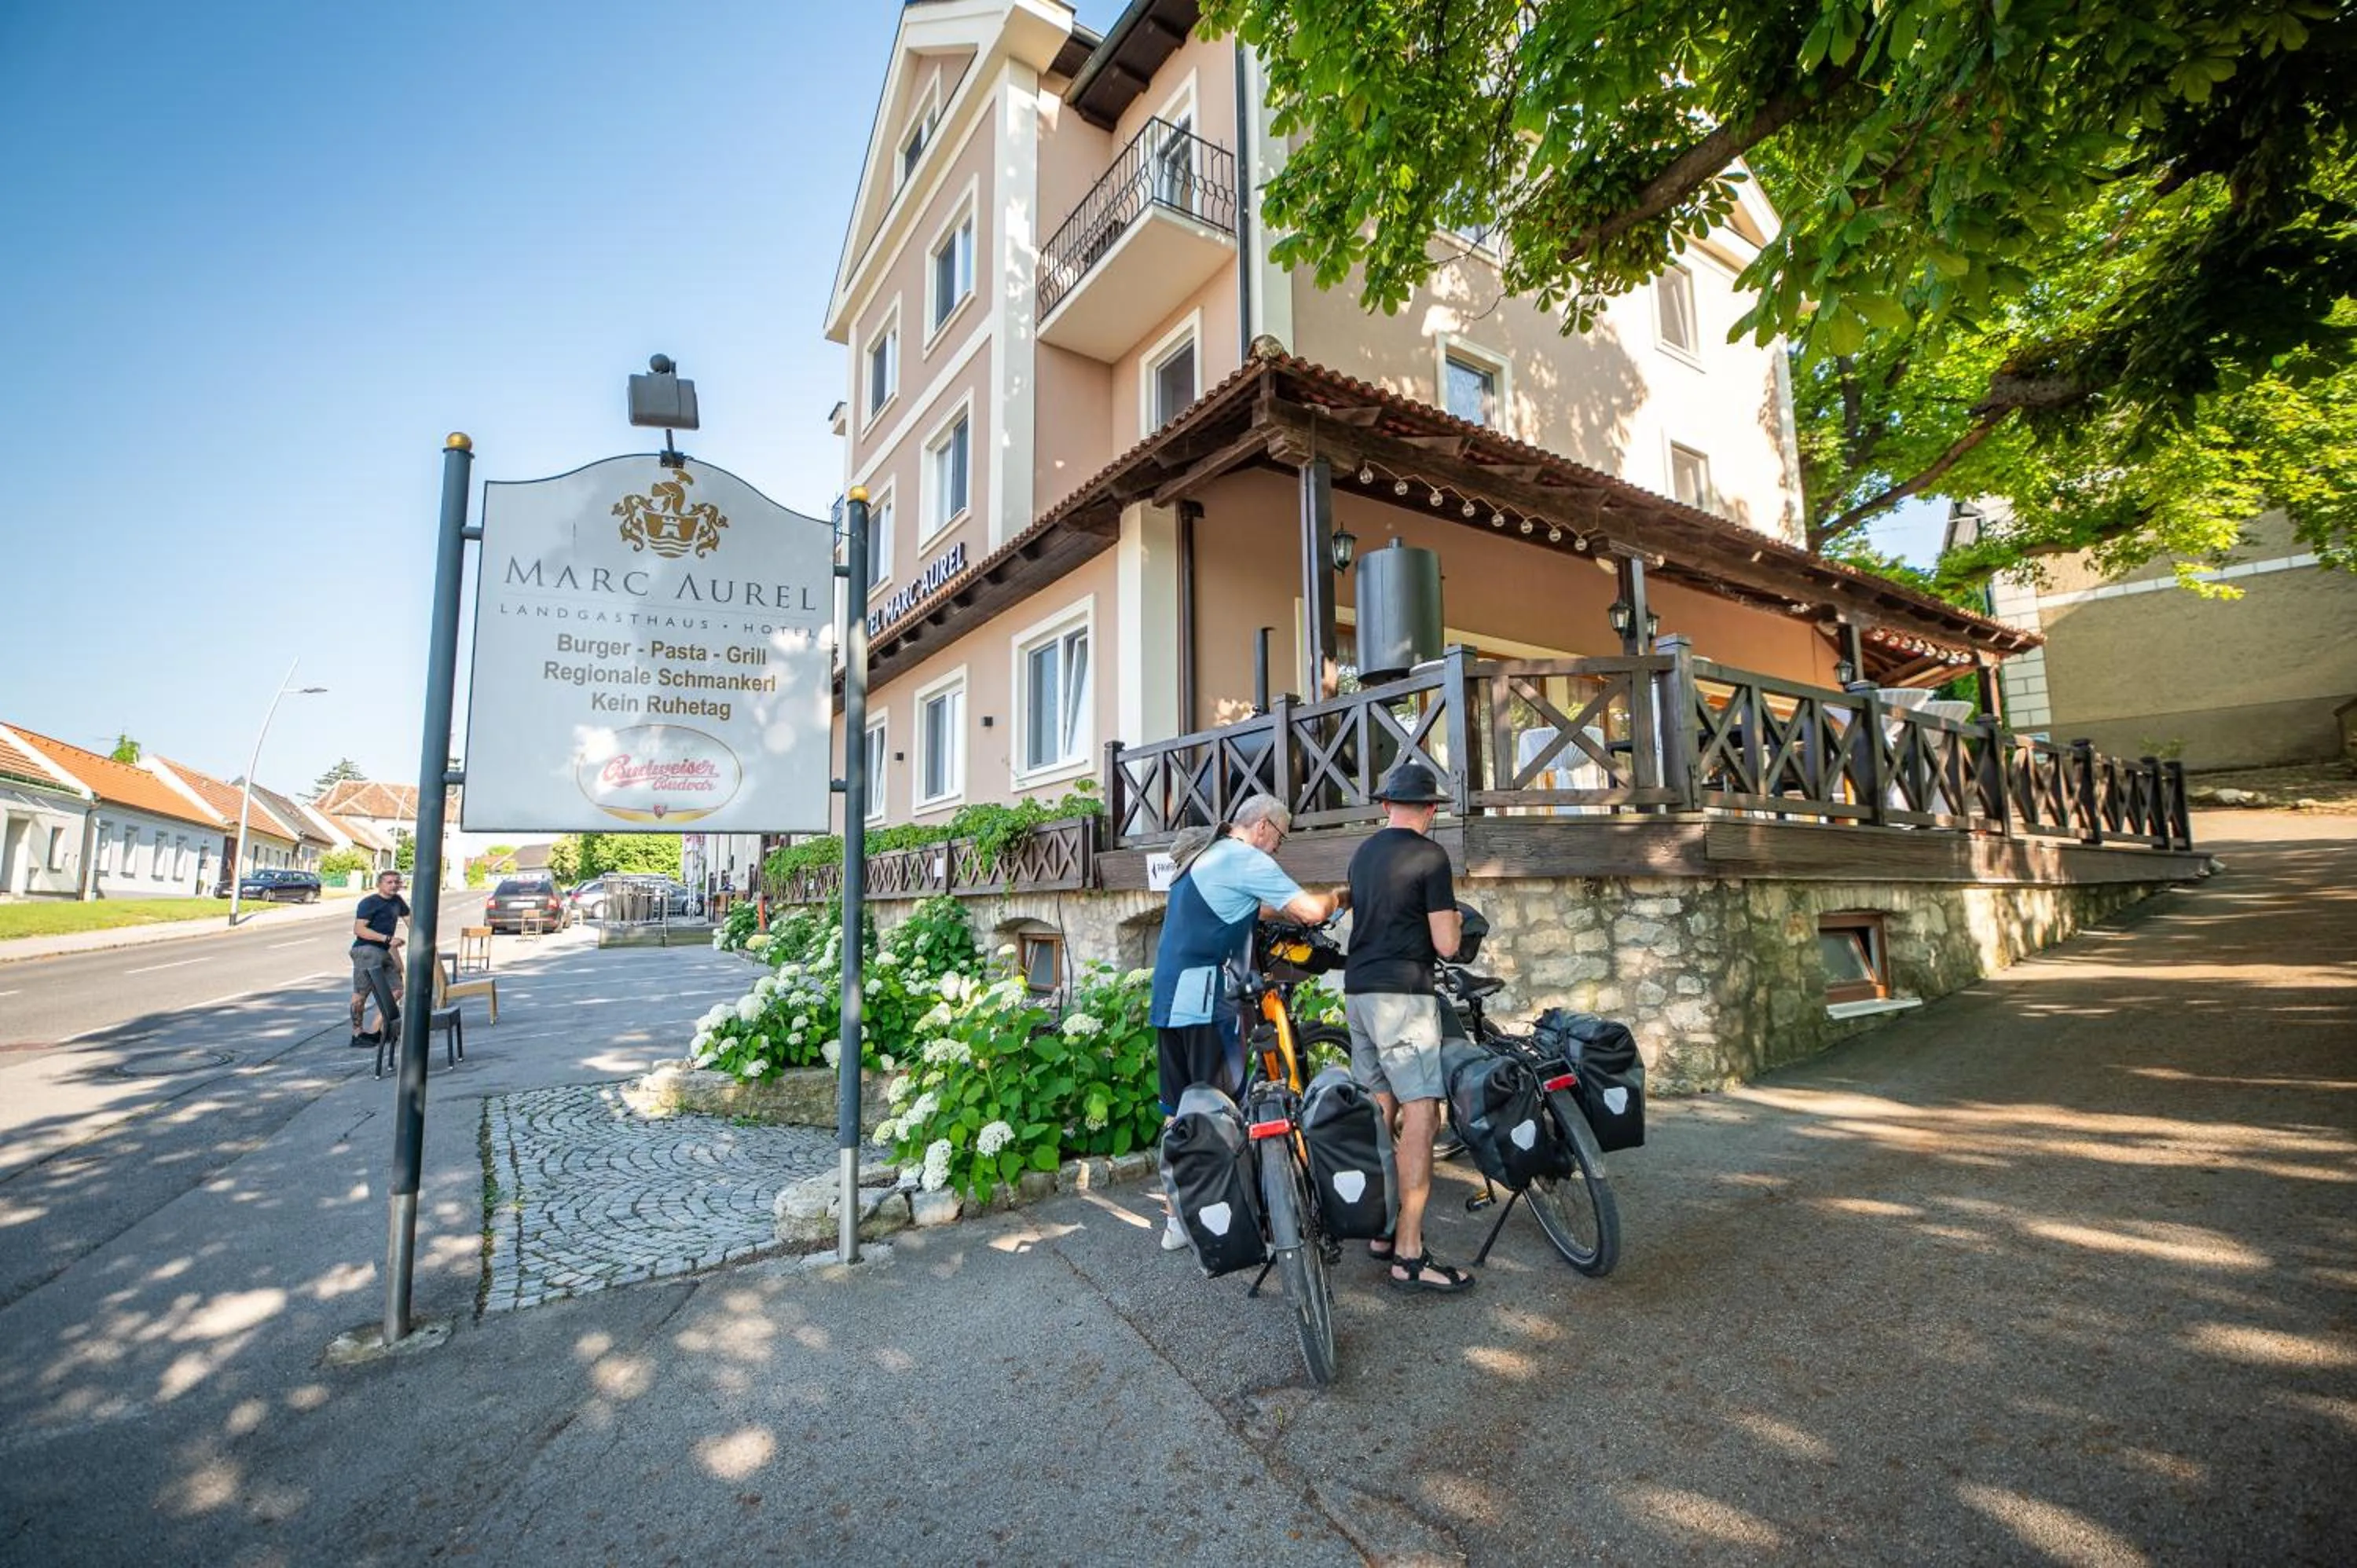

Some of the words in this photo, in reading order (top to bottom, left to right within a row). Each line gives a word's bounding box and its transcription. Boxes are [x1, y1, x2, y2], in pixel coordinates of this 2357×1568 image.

[504, 555, 651, 596] MARC
[675, 573, 817, 611] AUREL
[885, 578, 921, 627] MARC
[921, 542, 966, 597] AUREL
[500, 603, 709, 629] LANDGASTHAUS
[743, 623, 816, 639] HOTEL
[557, 633, 632, 659] Burger
[651, 640, 707, 661] Pasta
[726, 646, 767, 665] Grill
[543, 661, 651, 686] Regionale
[658, 669, 775, 691] Schmankerl
[591, 692, 639, 713] Kein
[647, 695, 731, 720] Ruhetag
[603, 753, 718, 786] Budweiser
